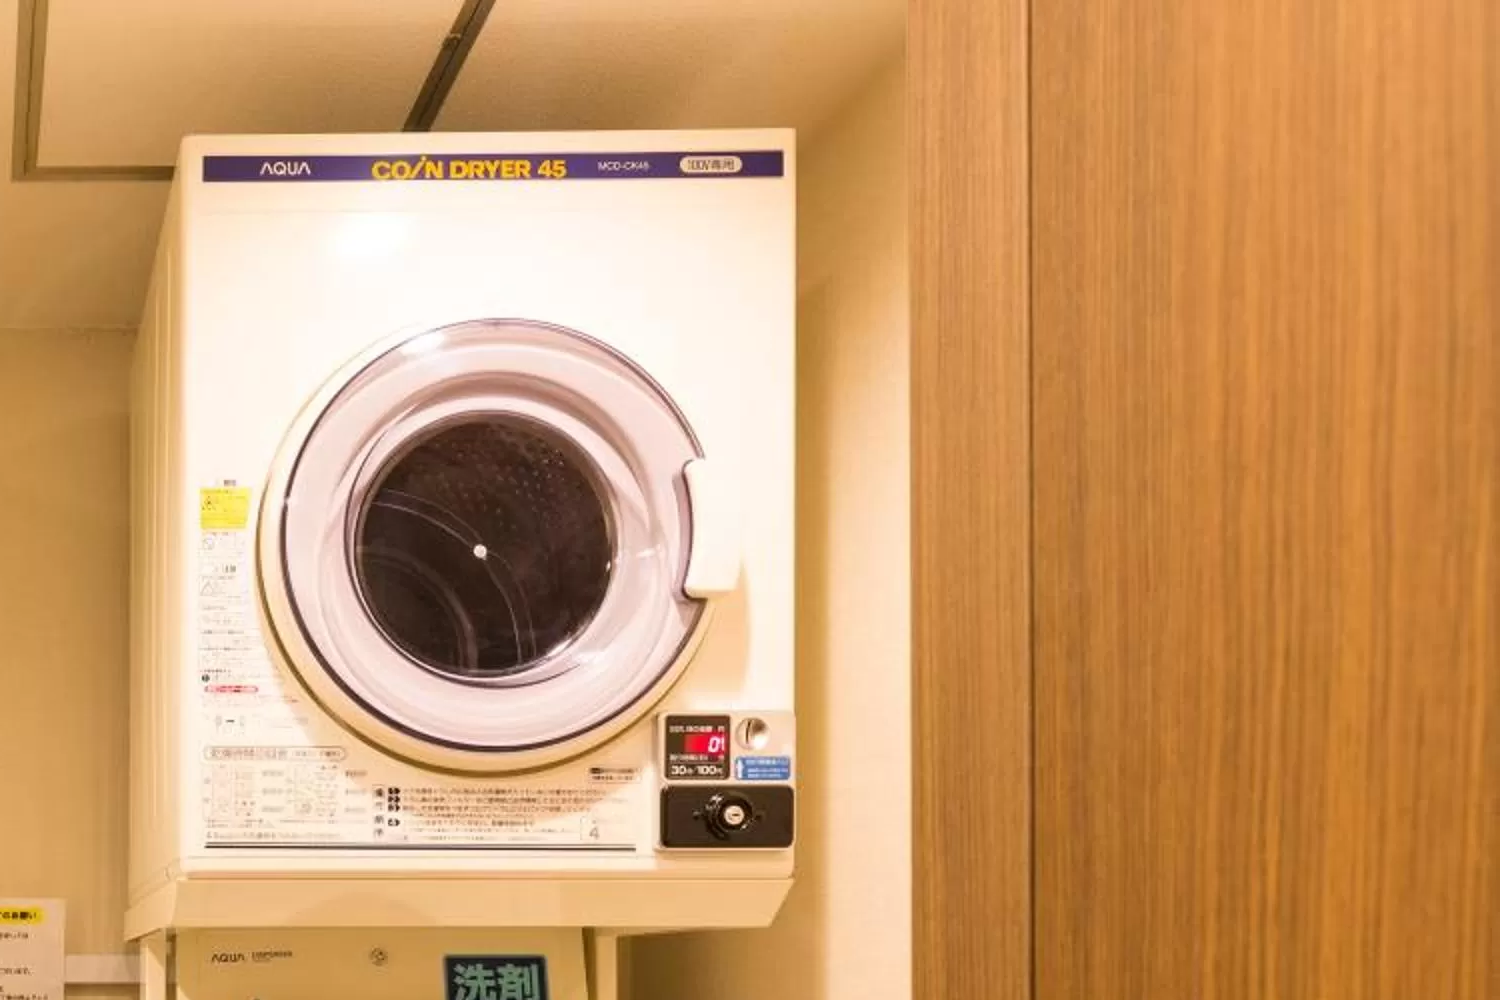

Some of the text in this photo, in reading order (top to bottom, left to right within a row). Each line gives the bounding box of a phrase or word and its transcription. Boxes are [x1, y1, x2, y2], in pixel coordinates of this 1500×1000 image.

[260, 161, 311, 176] AQUA
[449, 160, 531, 179] DRYER
[537, 159, 568, 179] 45
[211, 951, 245, 963] AQUA
